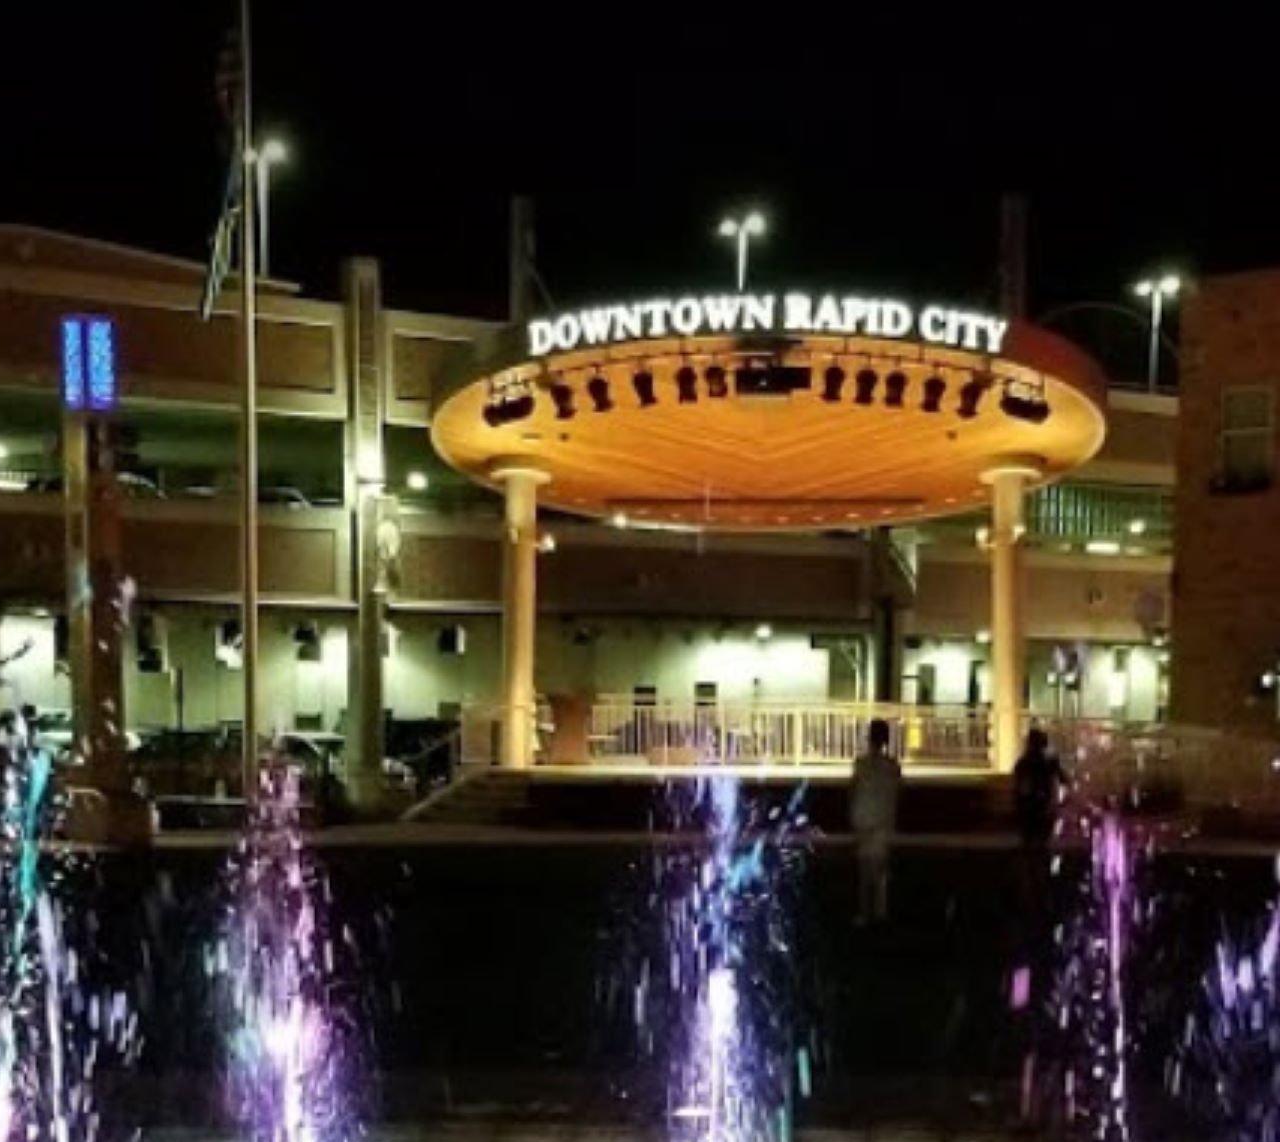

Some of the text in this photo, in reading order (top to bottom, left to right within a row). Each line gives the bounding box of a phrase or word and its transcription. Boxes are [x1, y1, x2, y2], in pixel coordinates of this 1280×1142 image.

[527, 293, 1007, 356] DOWNTOWN RAPID CITY
